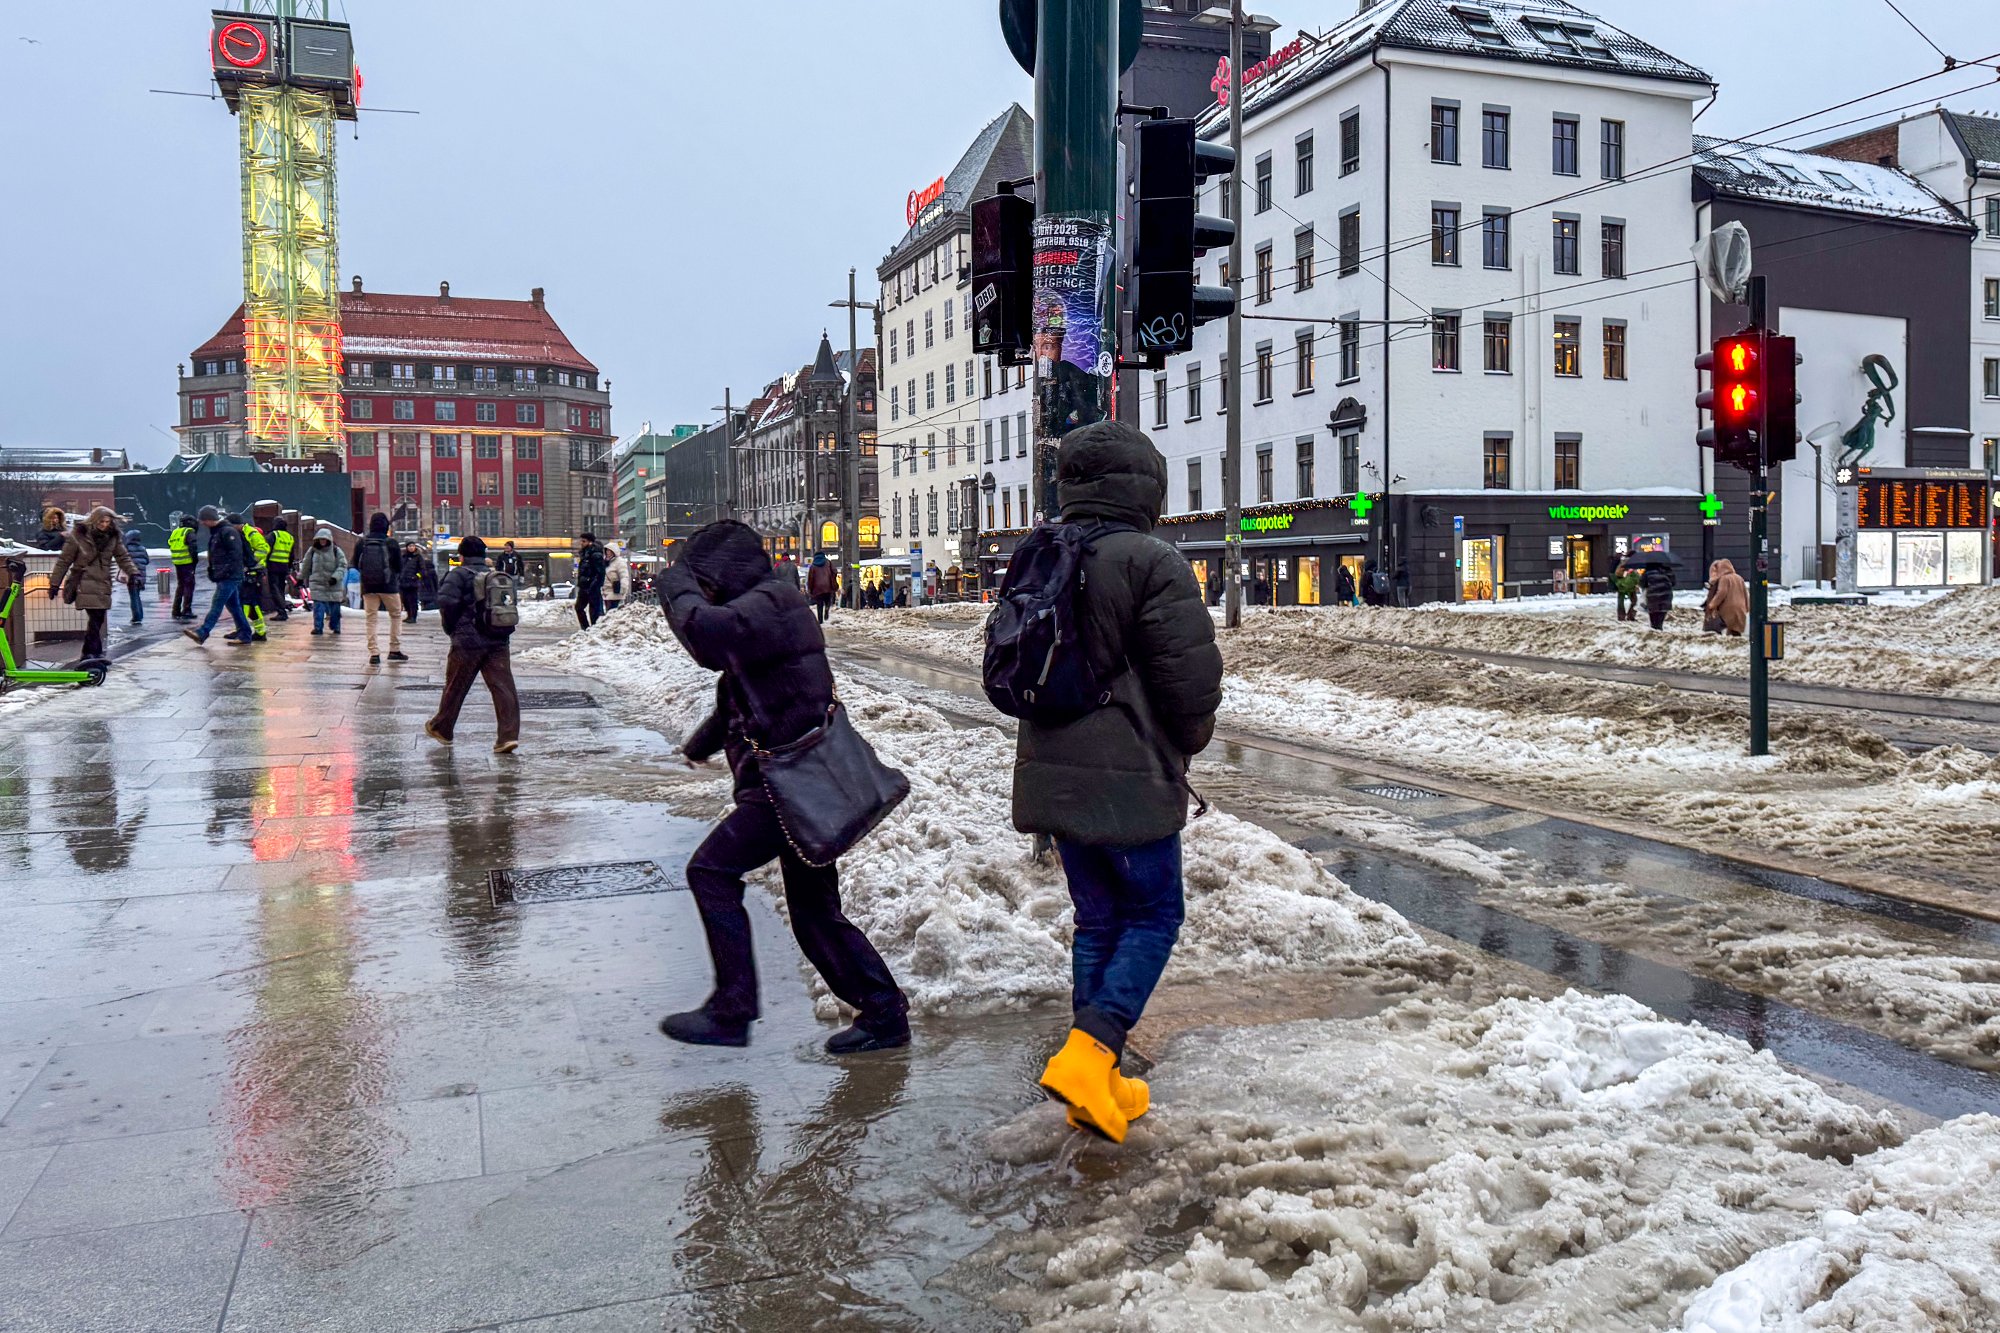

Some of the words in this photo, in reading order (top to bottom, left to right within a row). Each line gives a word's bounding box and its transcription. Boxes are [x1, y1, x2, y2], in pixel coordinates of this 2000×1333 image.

[1242, 60, 1265, 84] ADIO
[1267, 36, 1304, 70] NORGE
[1053, 224, 1078, 236] 2025
[1068, 236, 1089, 248] OSLO
[1139, 312, 1187, 347] NSC
